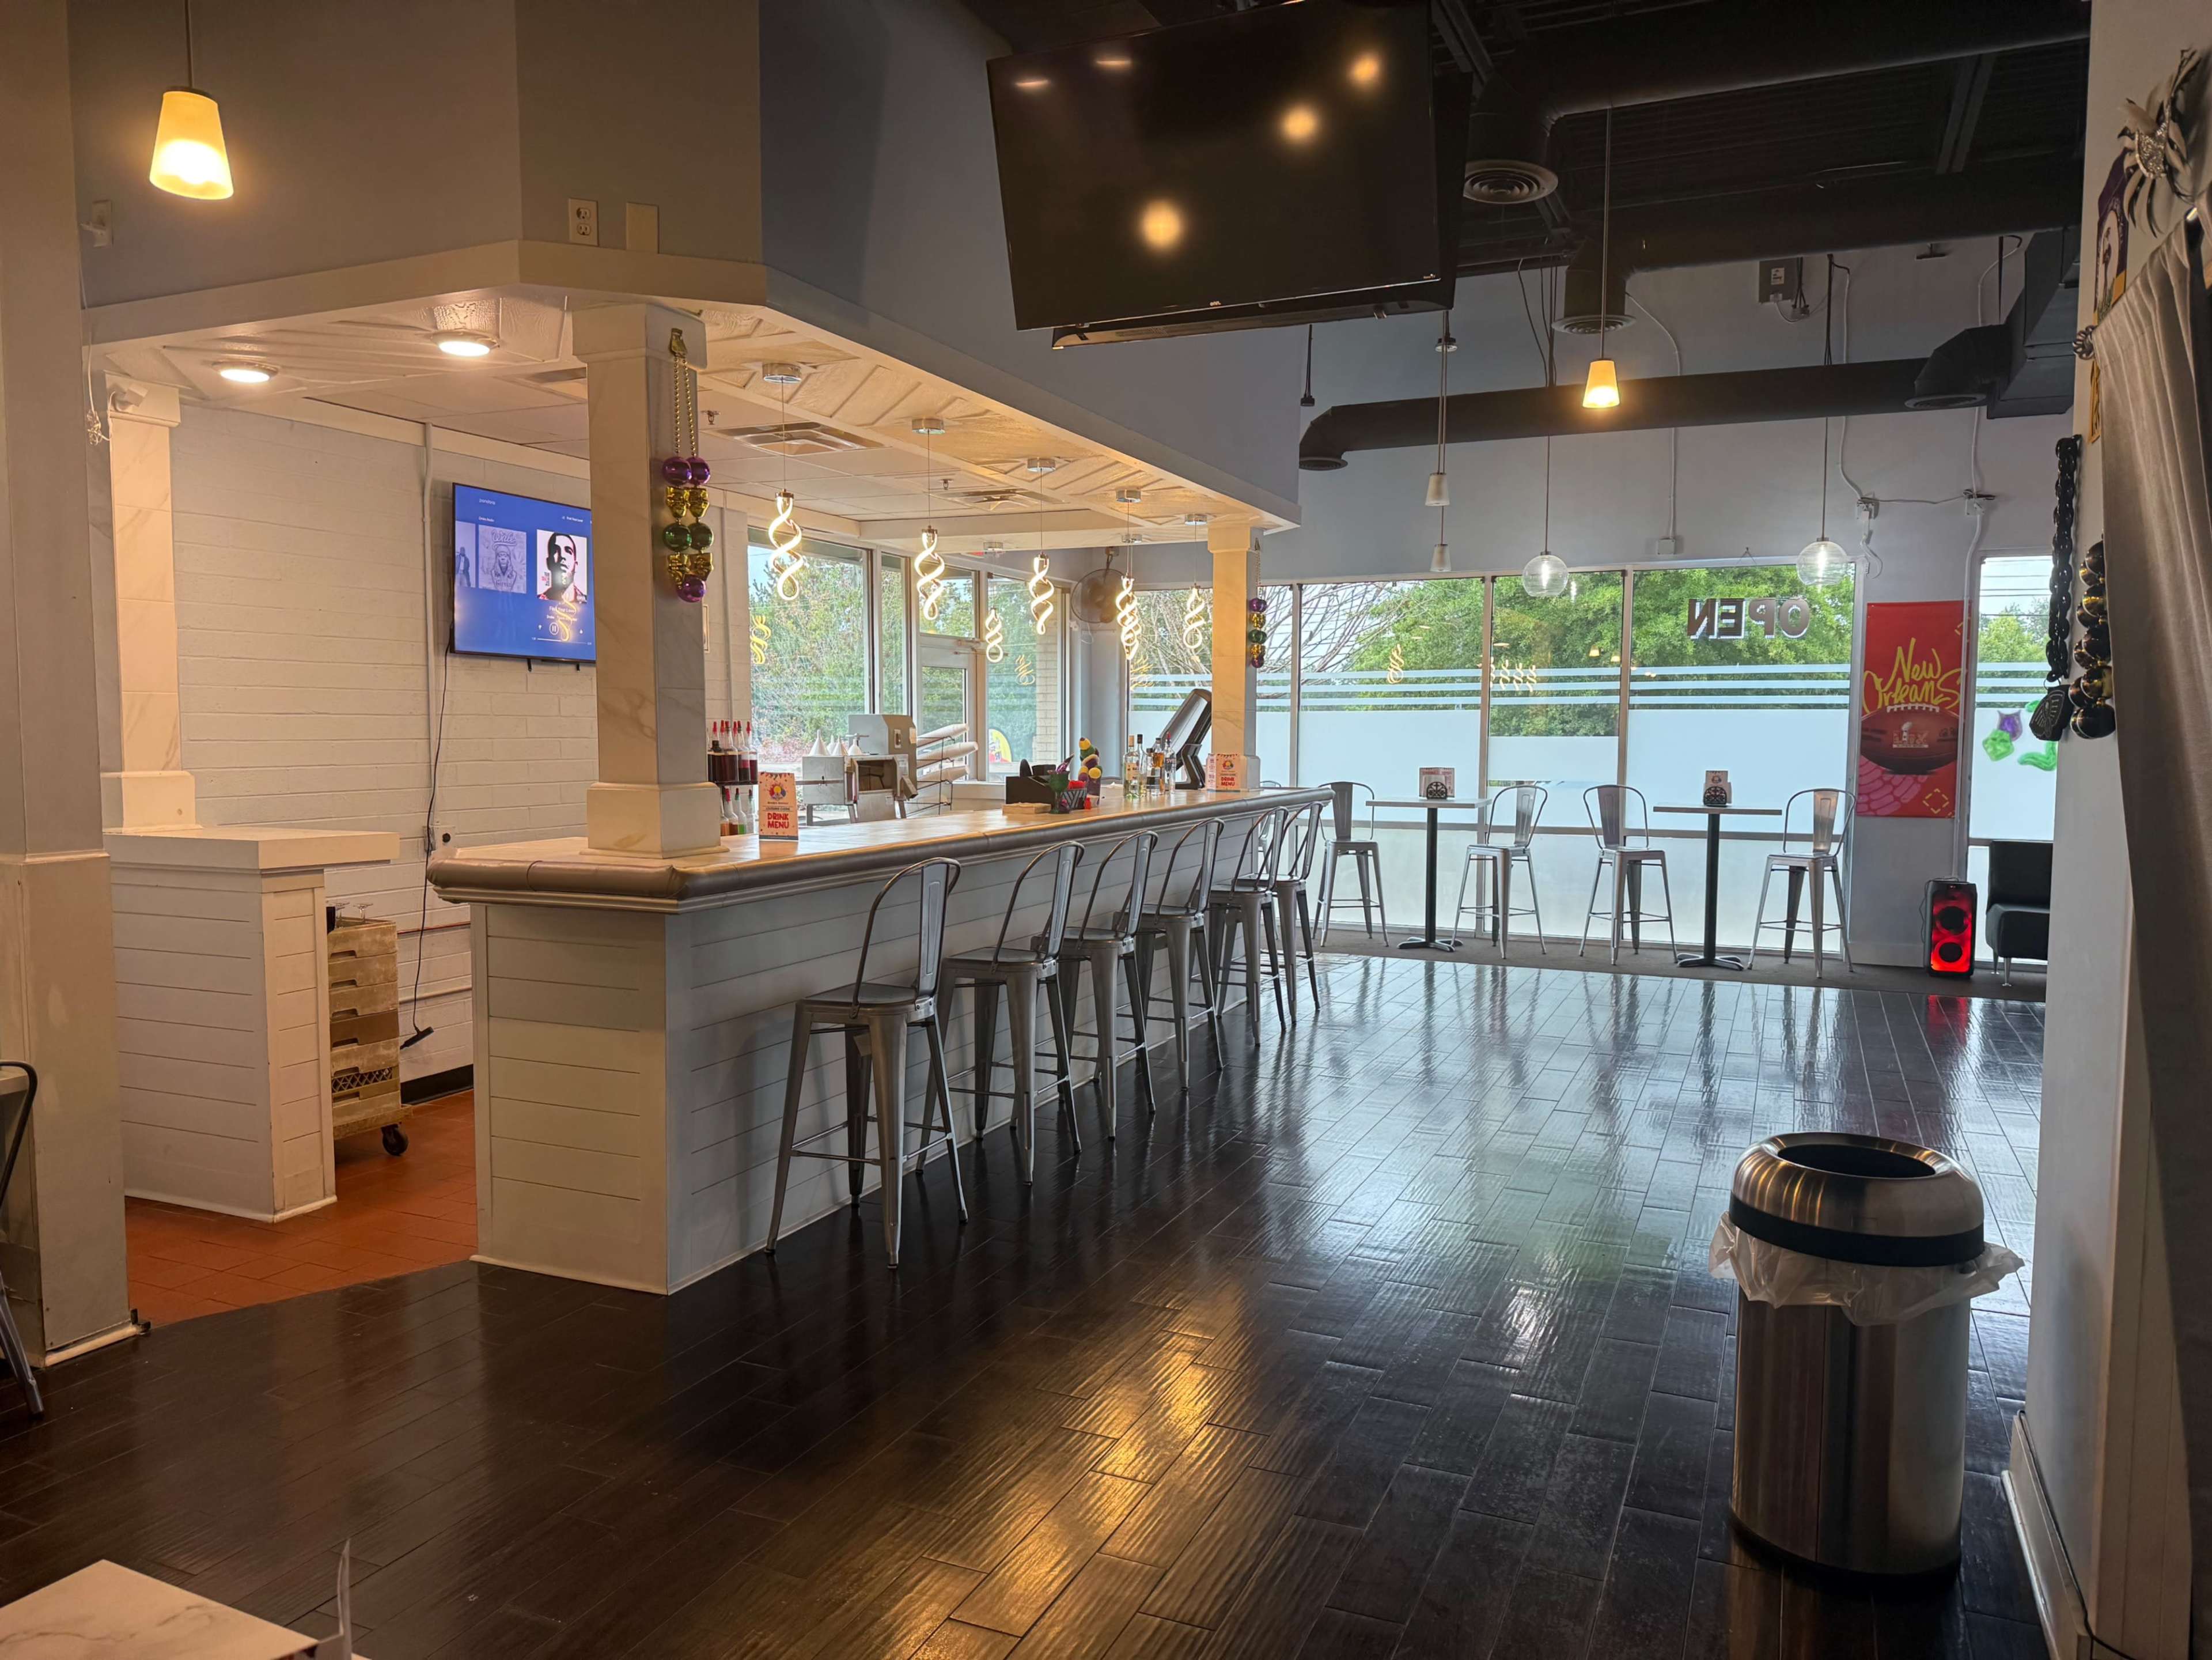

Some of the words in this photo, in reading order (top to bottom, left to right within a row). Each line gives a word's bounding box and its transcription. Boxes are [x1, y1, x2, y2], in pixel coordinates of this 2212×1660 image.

[1883, 637, 1942, 687] New
[767, 812, 789, 820] DRINK
[767, 820, 789, 829] MENU
